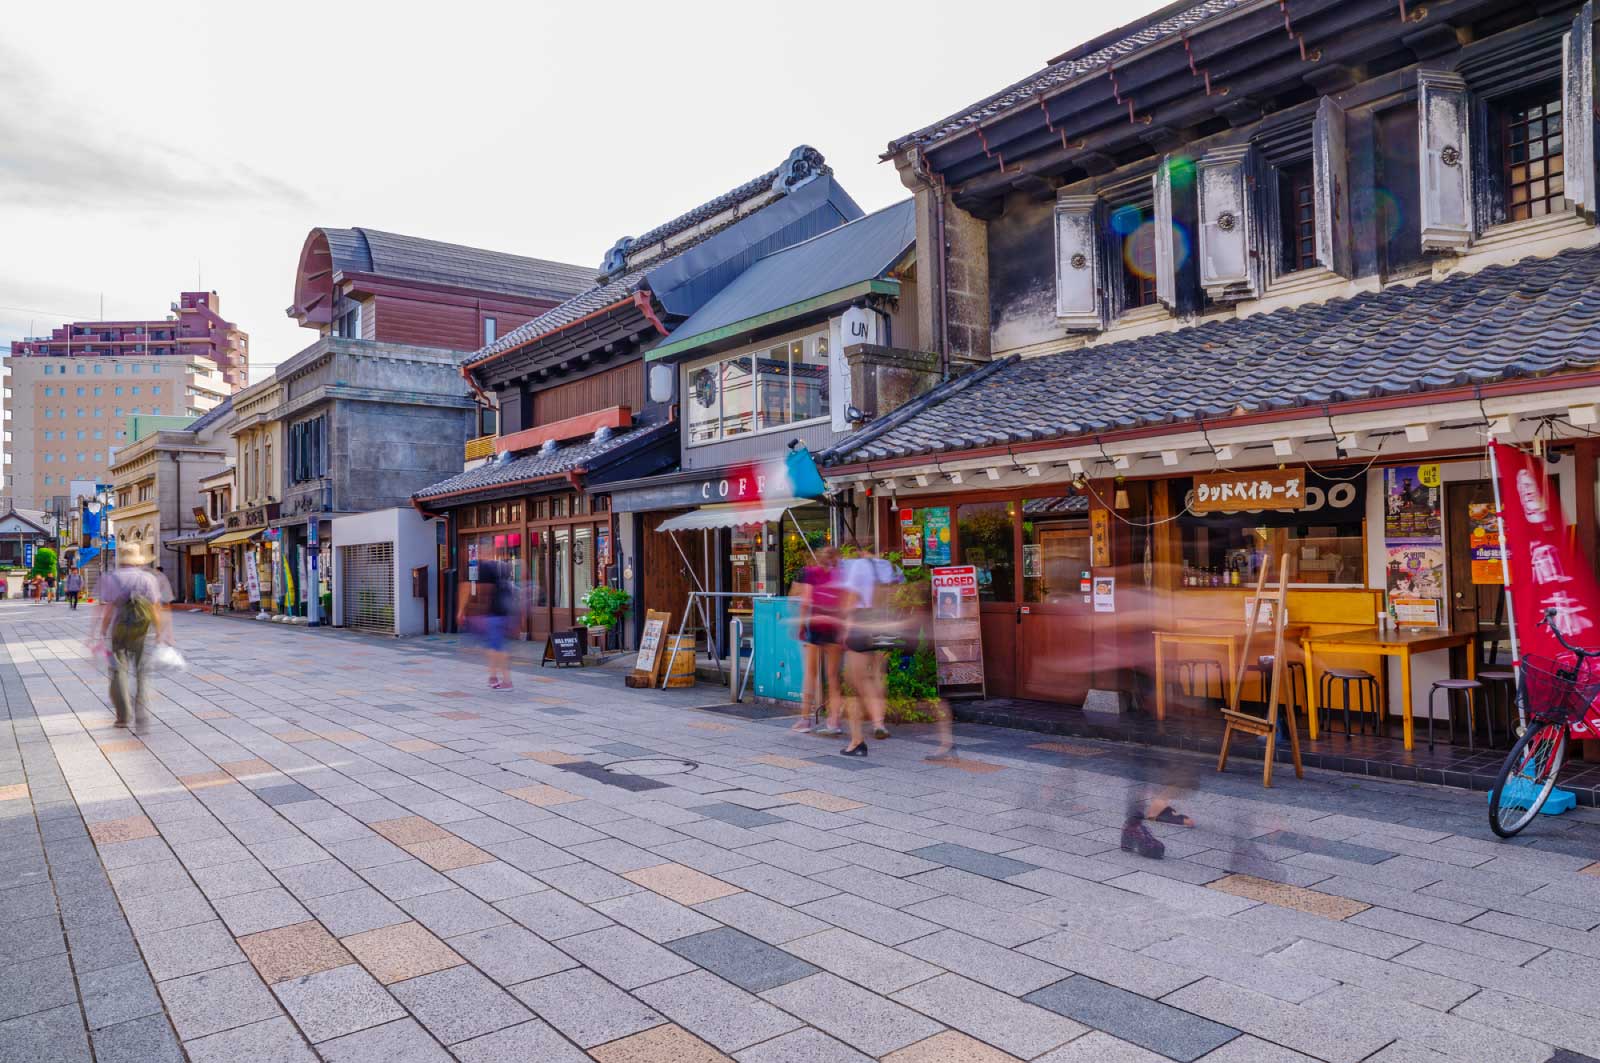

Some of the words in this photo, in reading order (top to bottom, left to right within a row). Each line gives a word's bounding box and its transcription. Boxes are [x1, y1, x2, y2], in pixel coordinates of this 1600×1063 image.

[851, 321, 869, 339] UN
[1197, 479, 1300, 502] ウッドベイカーズ
[933, 576, 974, 587] CLOSED
